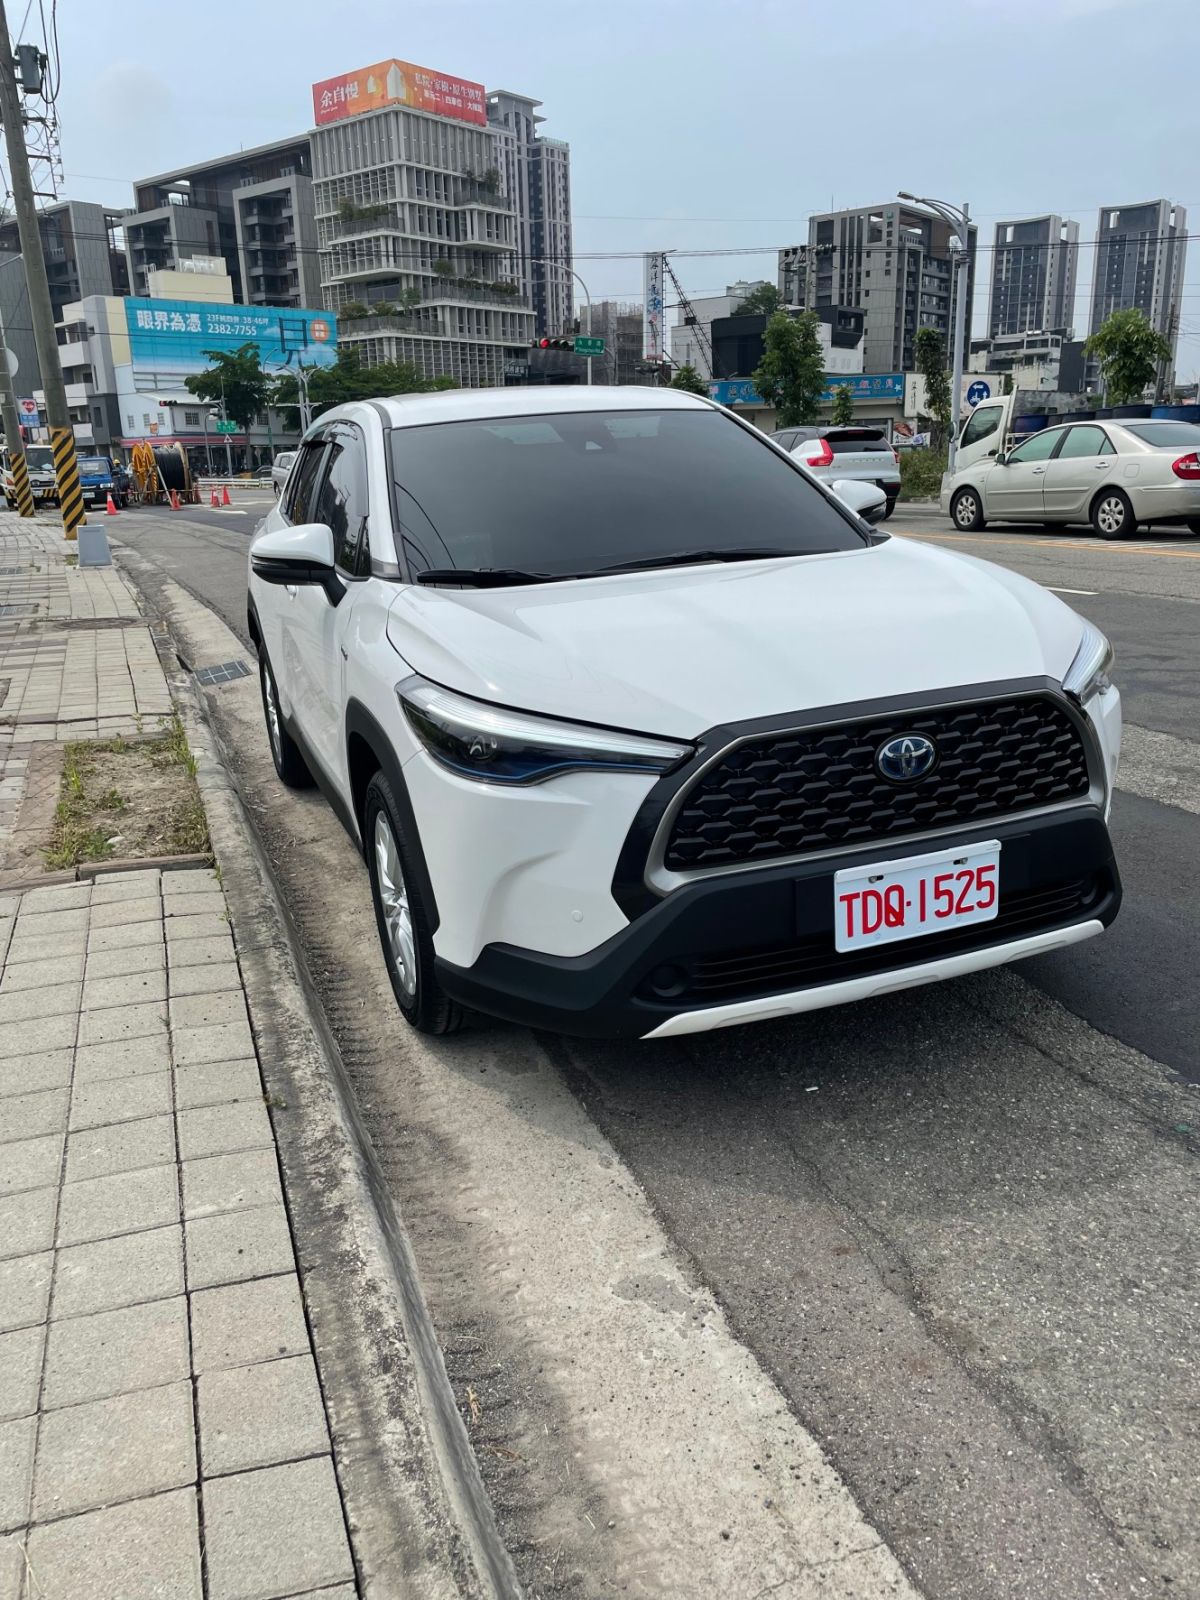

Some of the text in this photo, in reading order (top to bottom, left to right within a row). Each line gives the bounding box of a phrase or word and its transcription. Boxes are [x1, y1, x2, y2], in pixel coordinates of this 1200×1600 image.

[136, 310, 202, 332] 眼界為憑
[207, 323, 257, 336] 2382-7755
[839, 864, 996, 938] TDQ-1525
